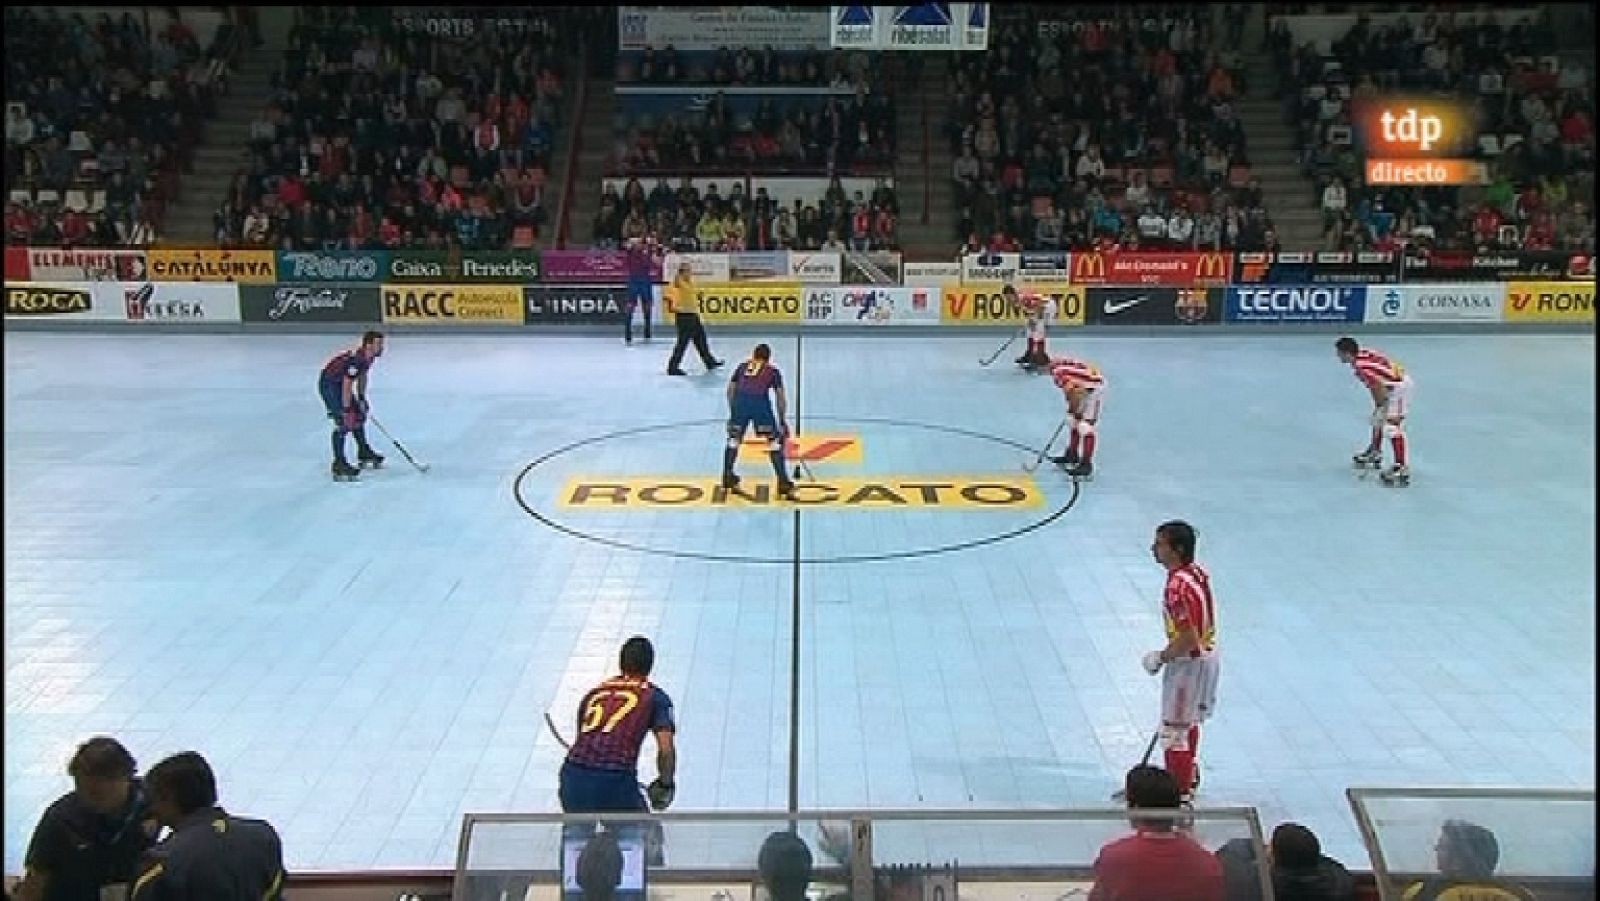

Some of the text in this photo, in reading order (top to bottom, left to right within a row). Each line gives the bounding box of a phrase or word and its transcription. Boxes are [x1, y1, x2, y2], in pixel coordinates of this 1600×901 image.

[391, 258, 441, 276] Caixa
[9, 290, 87, 310] ROCA
[384, 291, 455, 317] RACC
[974, 294, 1081, 319] RONTO
[1237, 289, 1347, 311] TECNOL
[1537, 293, 1596, 311] RON
